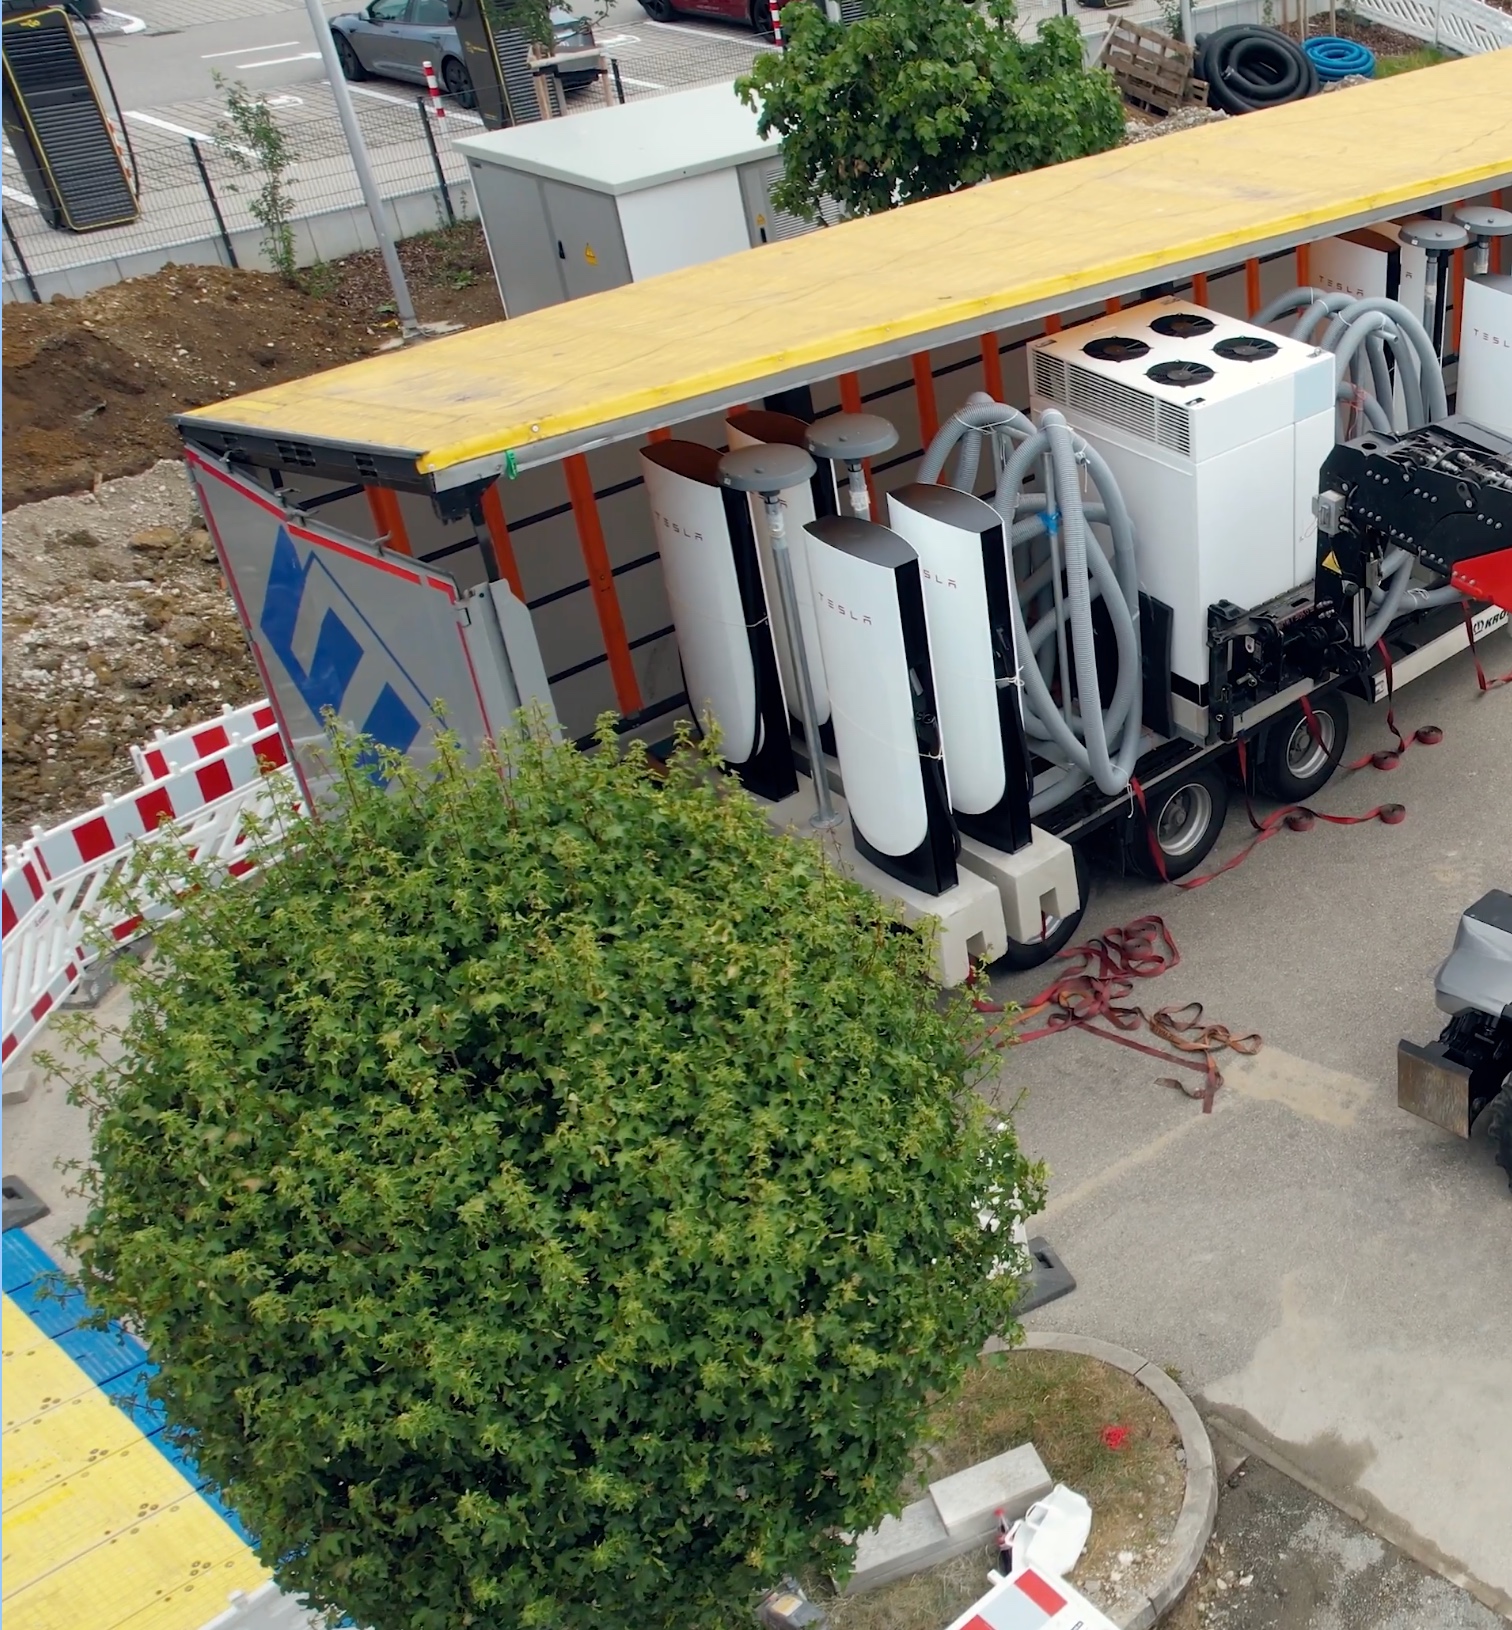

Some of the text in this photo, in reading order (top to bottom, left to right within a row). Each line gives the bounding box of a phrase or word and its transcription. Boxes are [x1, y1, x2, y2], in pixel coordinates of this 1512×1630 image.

[1318, 274, 1364, 297] TESLA
[655, 510, 703, 542] TESLA
[923, 569, 957, 589] SLA
[818, 592, 872, 625] TESLA
